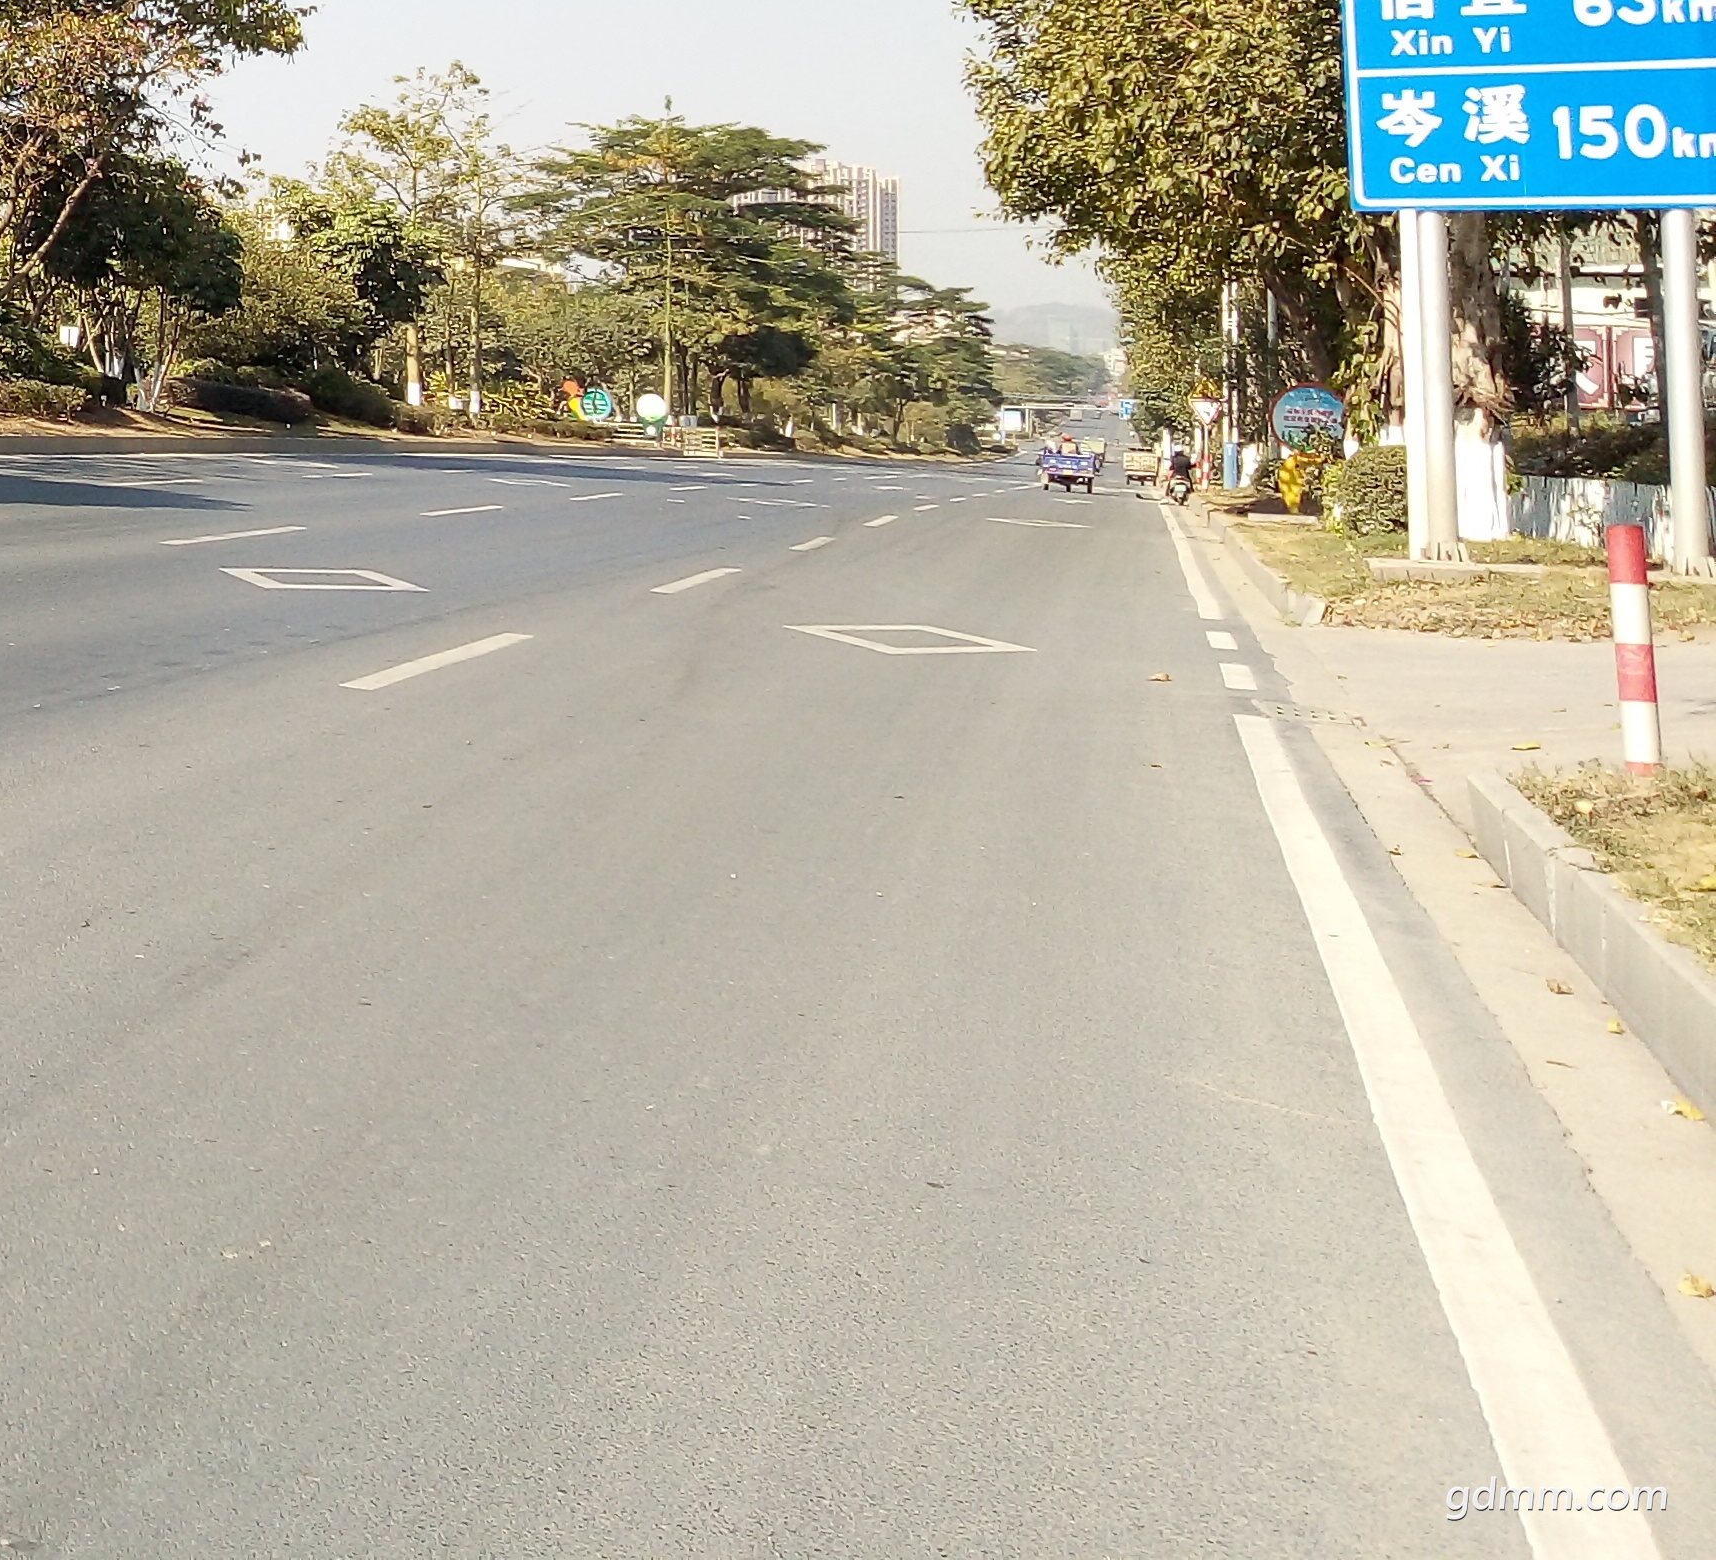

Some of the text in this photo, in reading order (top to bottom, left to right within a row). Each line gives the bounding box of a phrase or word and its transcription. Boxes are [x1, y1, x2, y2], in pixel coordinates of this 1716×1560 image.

[1392, 27, 1510, 55] Xin Yi
[1377, 85, 1529, 147] 岑溪
[1391, 155, 1519, 183] Cen Xi
